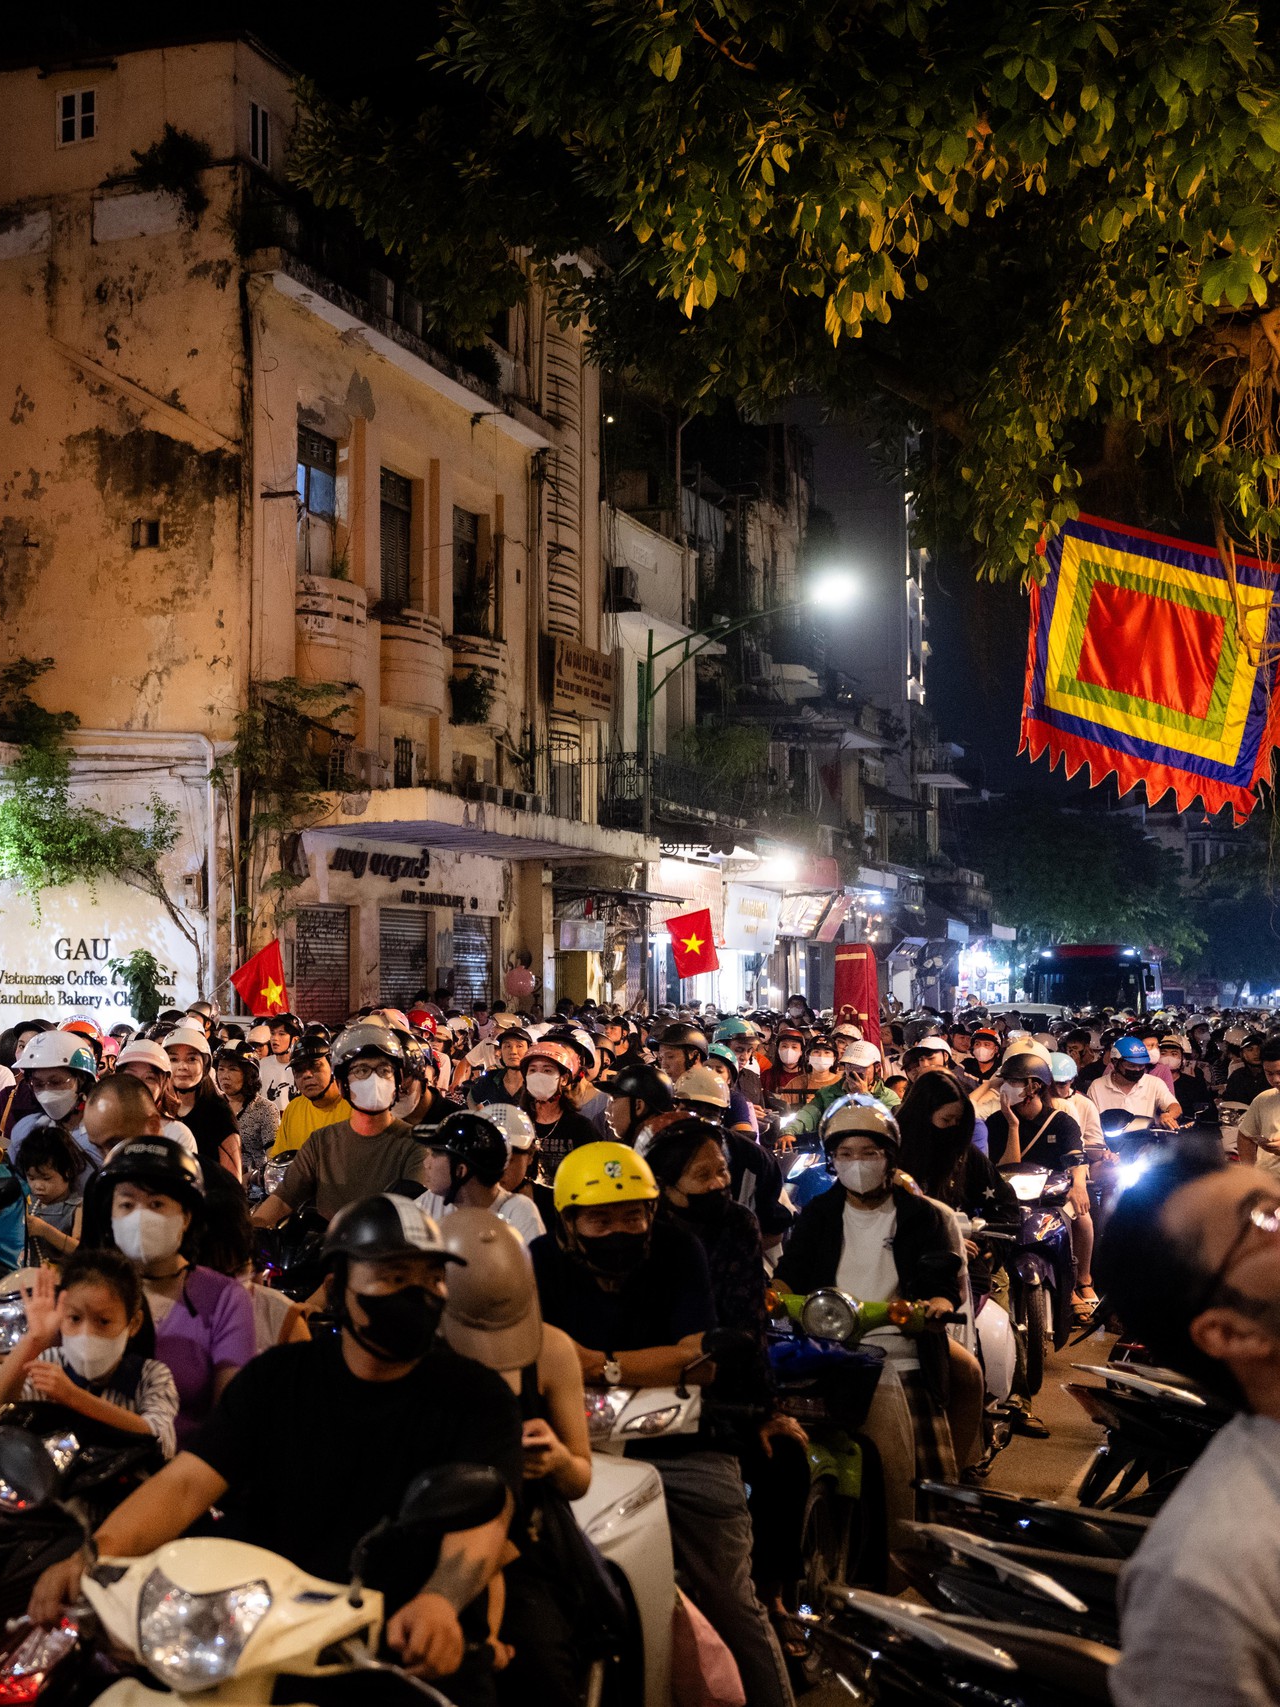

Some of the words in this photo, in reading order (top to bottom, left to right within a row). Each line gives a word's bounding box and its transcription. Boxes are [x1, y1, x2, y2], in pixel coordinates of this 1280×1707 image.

[54, 938, 111, 961] GAU
[67, 969, 107, 986] Coffee
[153, 969, 178, 986] eaf
[57, 990, 102, 1009] Bakery
